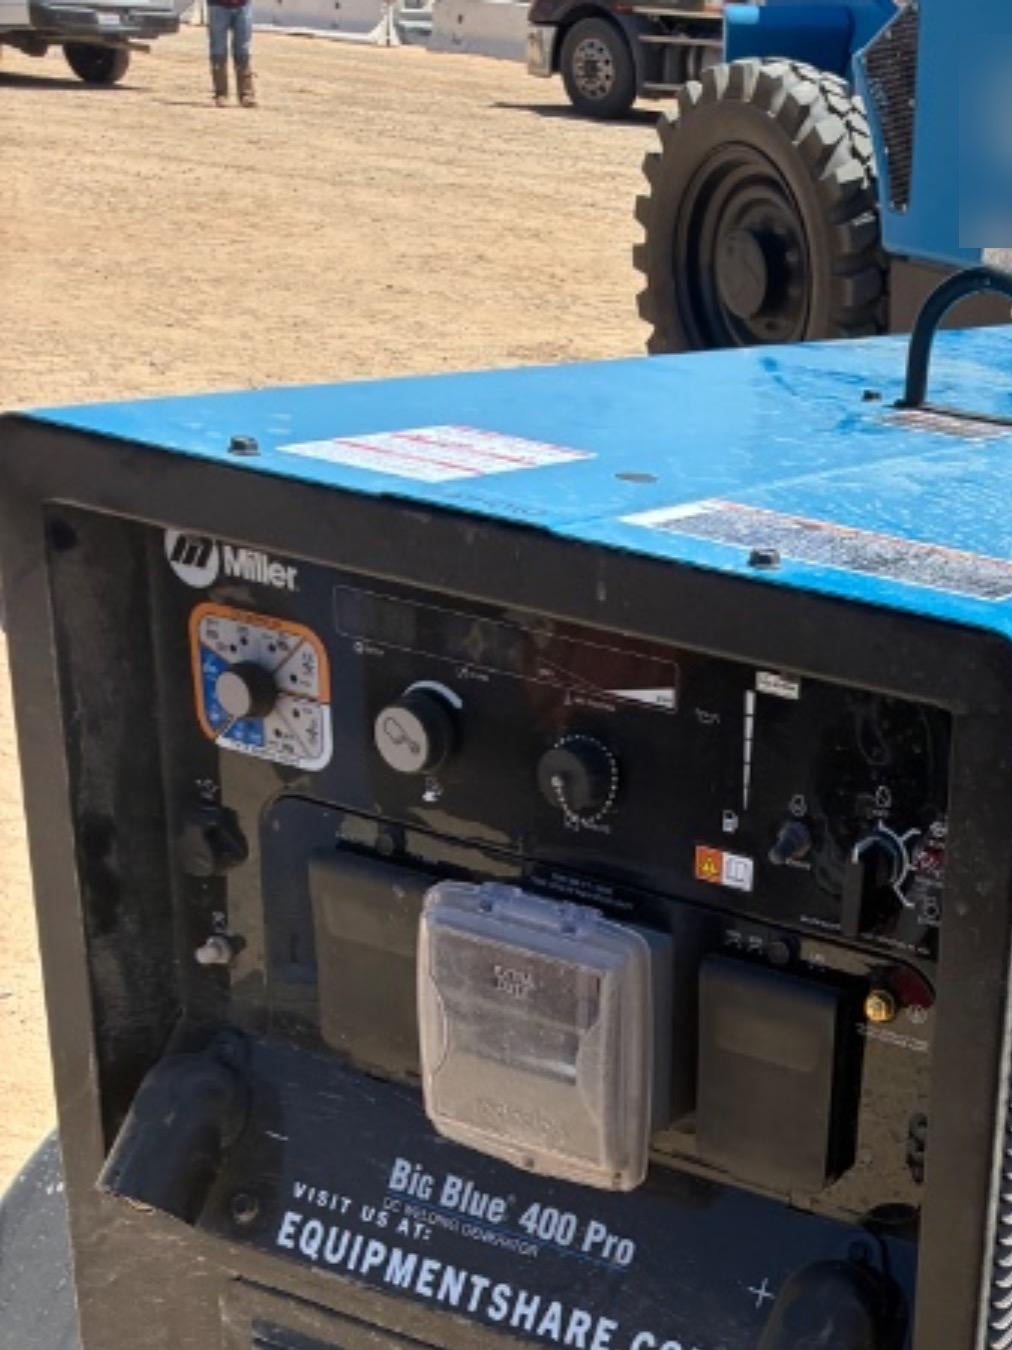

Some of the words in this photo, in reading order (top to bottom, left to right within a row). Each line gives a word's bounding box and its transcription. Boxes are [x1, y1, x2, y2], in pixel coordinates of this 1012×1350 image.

[223, 544, 298, 591] Miller
[293, 1181, 352, 1214] VISIT
[361, 1205, 390, 1228] US
[396, 1217, 433, 1241] AT:
[518, 1202, 578, 1246] 400
[581, 1220, 636, 1265] Pro
